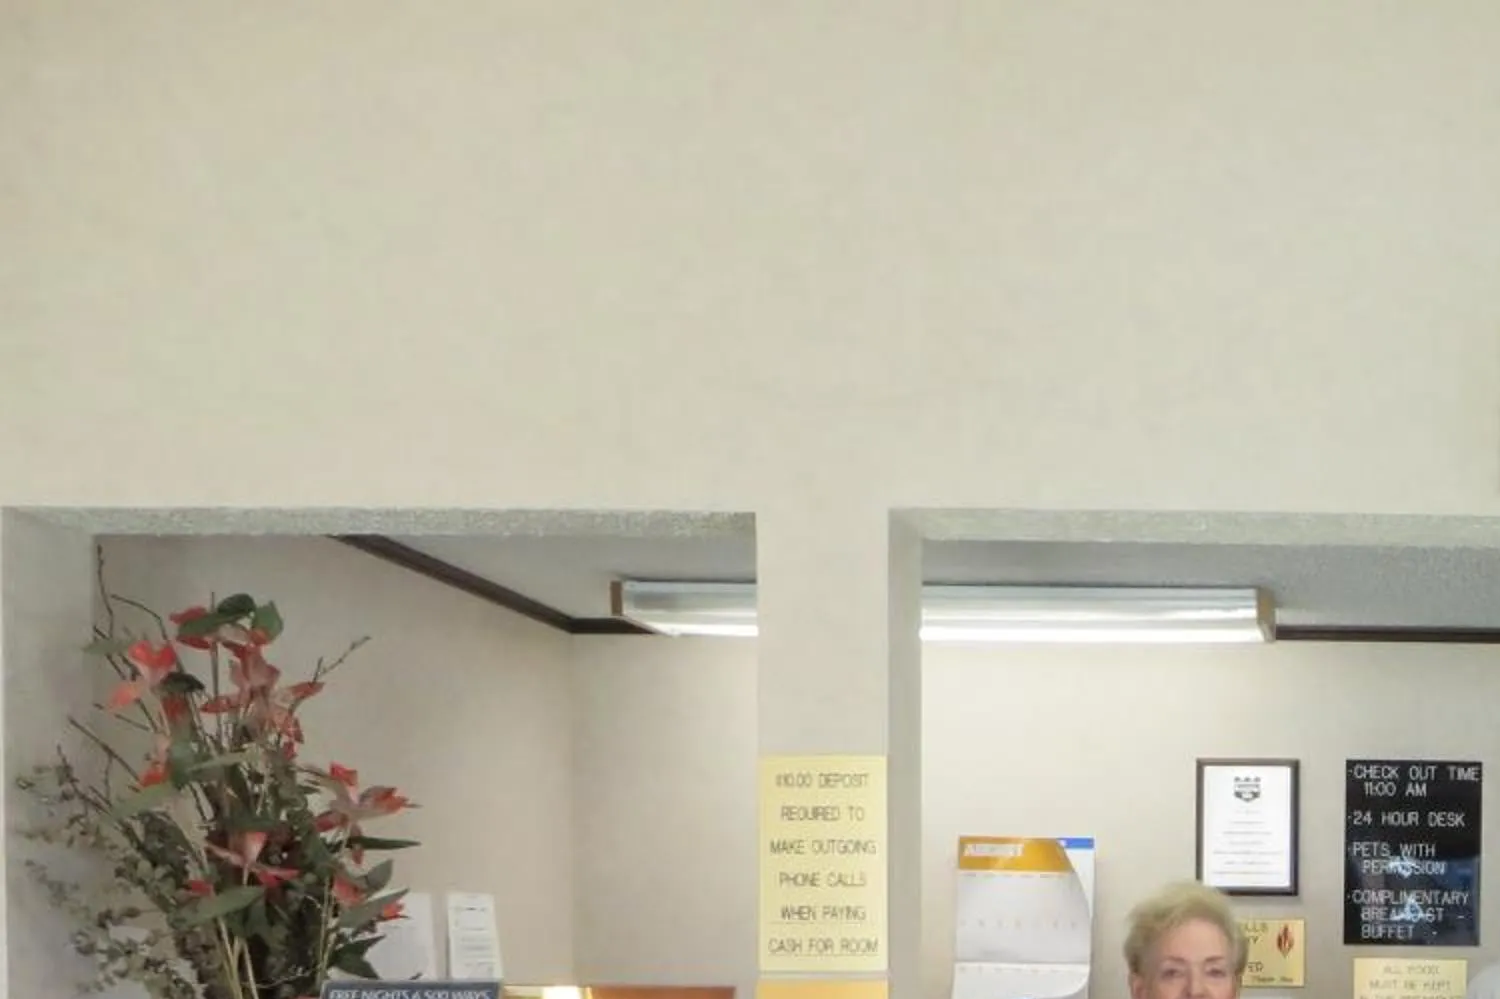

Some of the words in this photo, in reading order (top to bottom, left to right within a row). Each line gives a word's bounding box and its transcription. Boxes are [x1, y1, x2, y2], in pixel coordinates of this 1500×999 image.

[818, 772, 870, 789] DEPOSIT
[1354, 765, 1399, 779] CHECK
[1409, 765, 1438, 781] OUT
[1448, 766, 1480, 781] TIME
[1364, 781, 1397, 796] 11:00
[1405, 782, 1427, 797] AM
[780, 805, 840, 822] REQUIRED
[849, 806, 865, 822] TO
[1352, 810, 1372, 825] 24
[1381, 811, 1419, 826] HOUR
[1428, 812, 1466, 827] DESK
[769, 838, 806, 855] MAKE
[811, 839, 877, 855] OUTGOING
[1353, 842, 1390, 857] PETS
[1400, 843, 1436, 857] WITH
[1362, 859, 1447, 876] PERMSION
[778, 871, 821, 888] PHONE
[826, 871, 866, 888] CALLS
[780, 904, 816, 921] WHEN
[822, 905, 866, 921] PAYING
[1361, 907, 1444, 923] BREAST
[1361, 924, 1415, 939] BUFFET
[767, 937, 802, 953] CASH
[808, 937, 834, 953] FOR
[840, 937, 879, 953] ROOM
